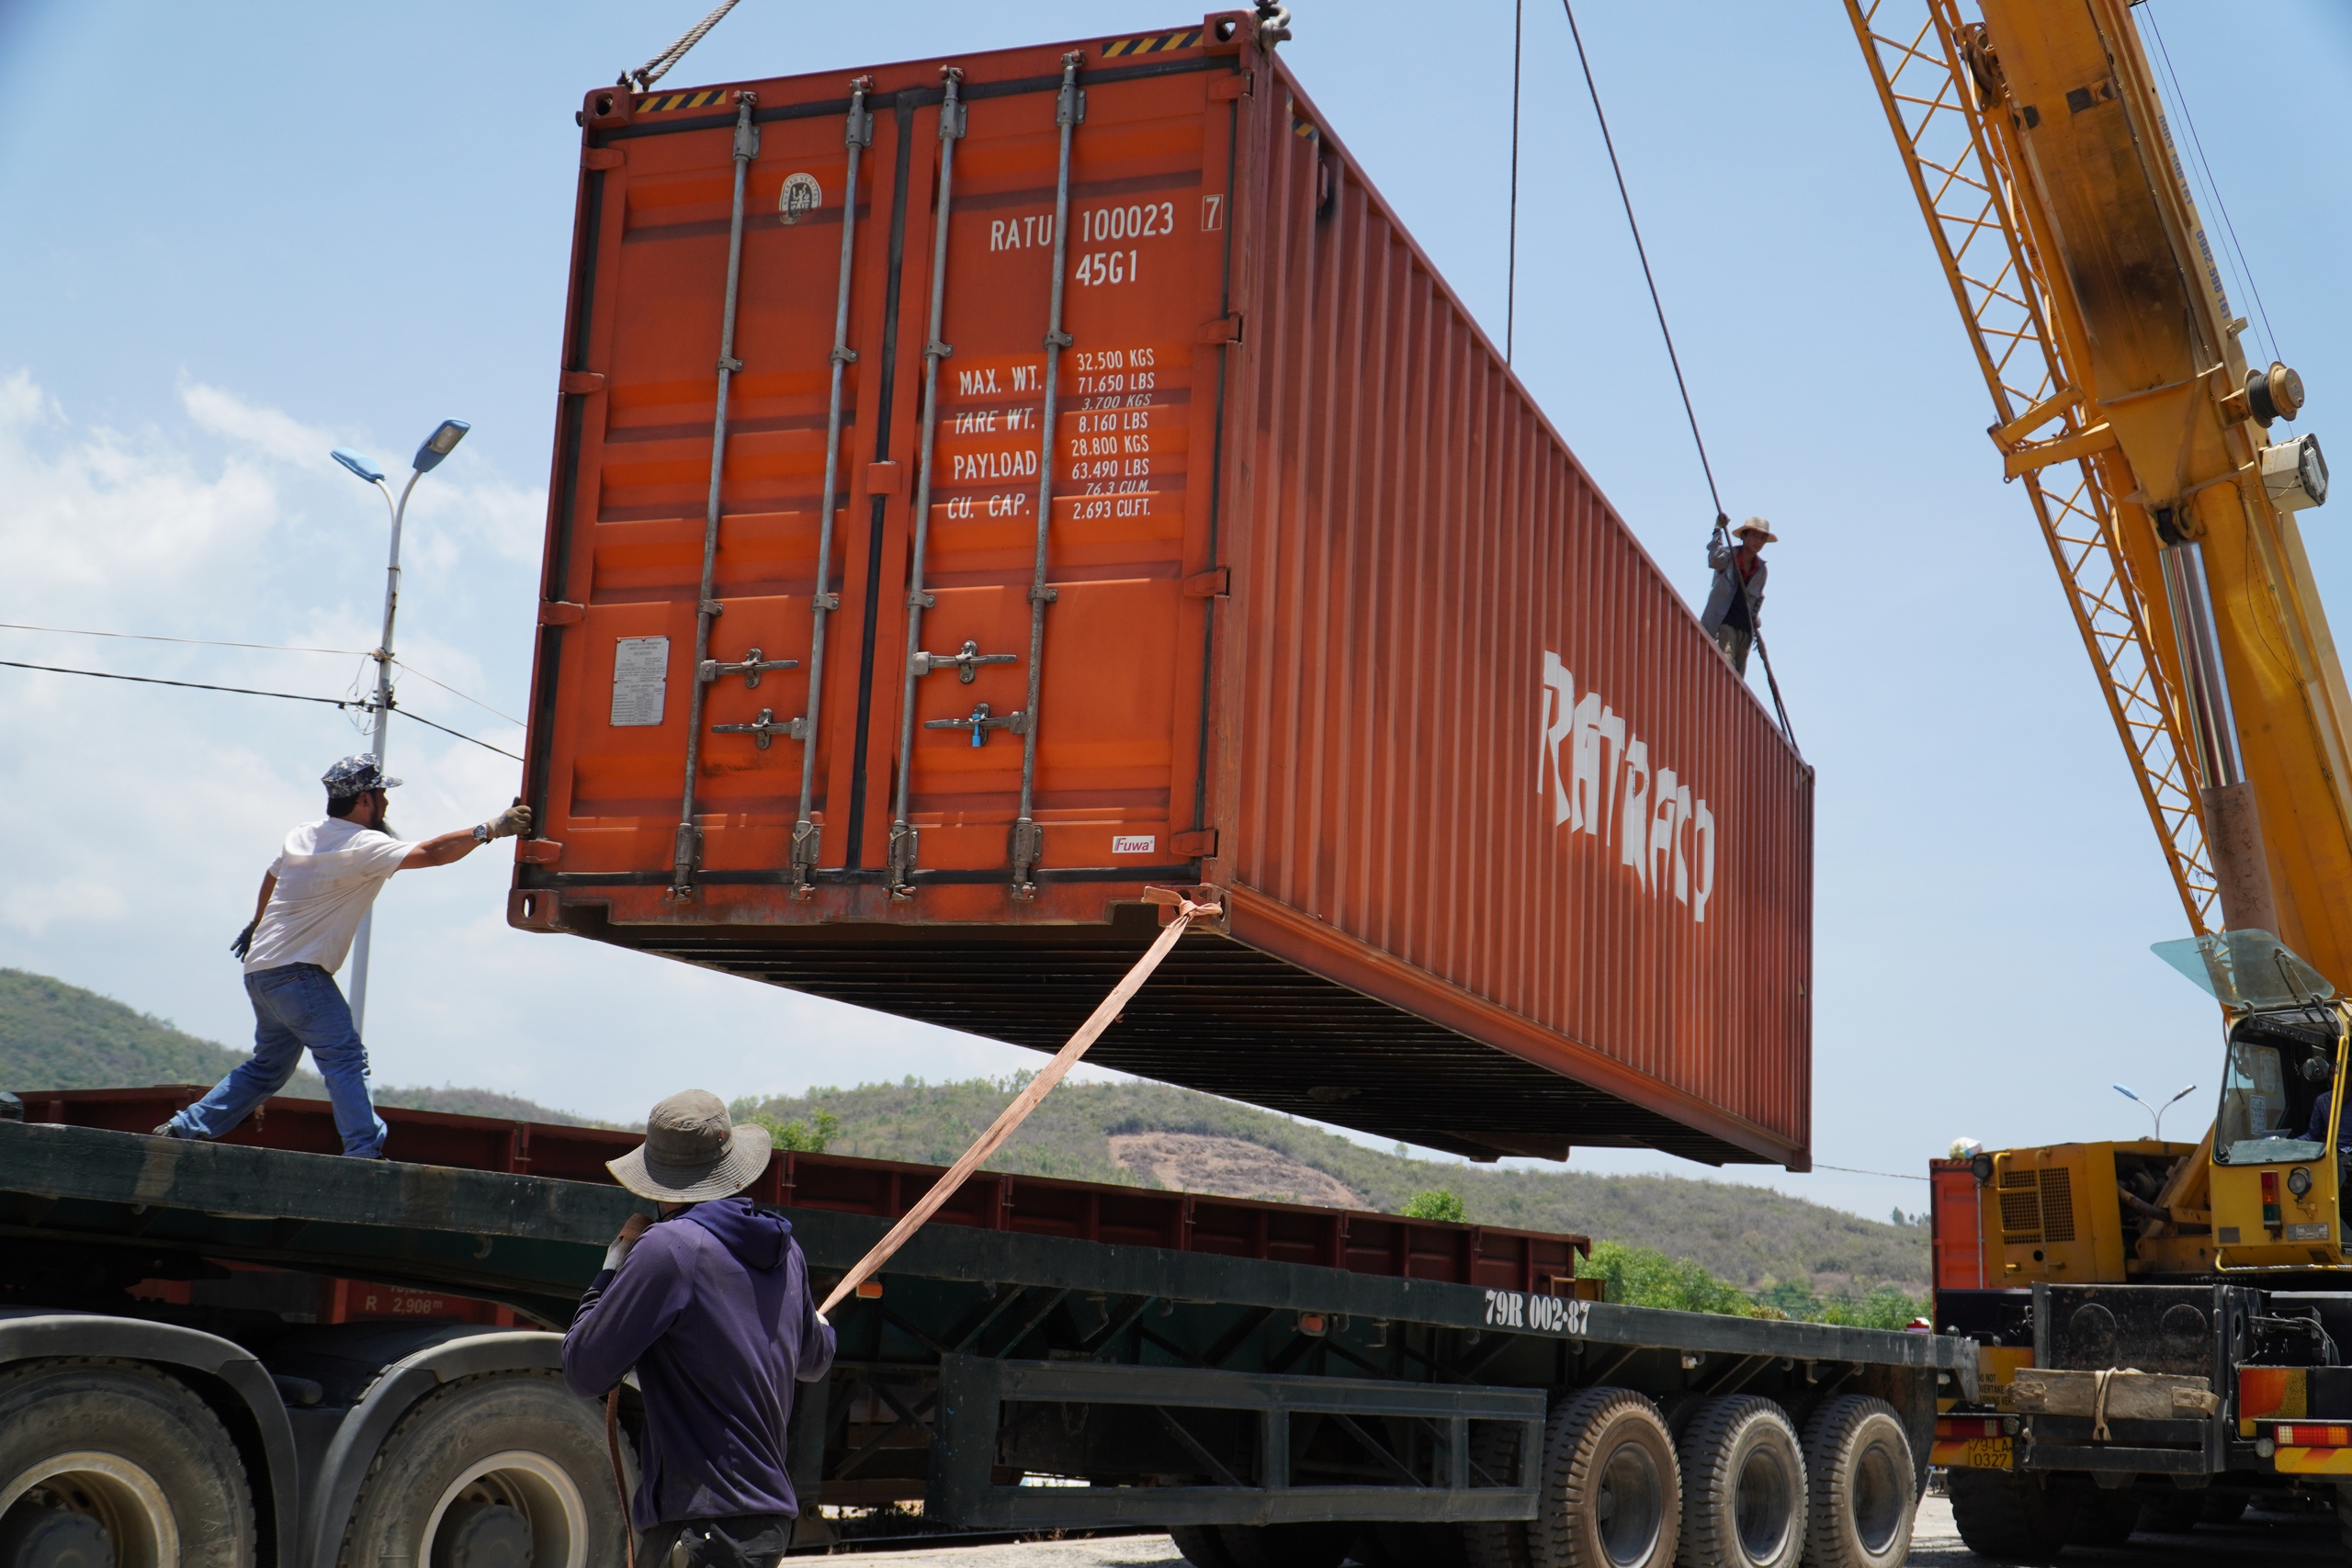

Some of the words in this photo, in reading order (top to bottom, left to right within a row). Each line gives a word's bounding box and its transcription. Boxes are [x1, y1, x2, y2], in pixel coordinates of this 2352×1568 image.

[990, 214, 1053, 252] RATU
[1083, 201, 1173, 242] 100023
[1206, 196, 1220, 229] 7
[1075, 249, 1137, 286] 45G1
[959, 368, 1001, 396] MAX.
[1012, 365, 1043, 391] WT.
[1129, 348, 1155, 367] KGS
[1130, 372, 1155, 389] LBS
[955, 410, 999, 434] TARE
[1007, 407, 1035, 431] WT.
[1125, 393, 1152, 408] KGS
[1124, 412, 1148, 430] LBS
[954, 449, 1037, 480] PAYLOAD
[1125, 434, 1149, 453] KGS
[1125, 458, 1150, 477] LBS
[947, 496, 974, 519] CU.
[989, 492, 1030, 517] CAP.
[365, 1295, 378, 1311] R
[1486, 1290, 1524, 1328] 79R
[1985, 1373, 1996, 1382] NOT
[1974, 1453, 2007, 1467] 0327
